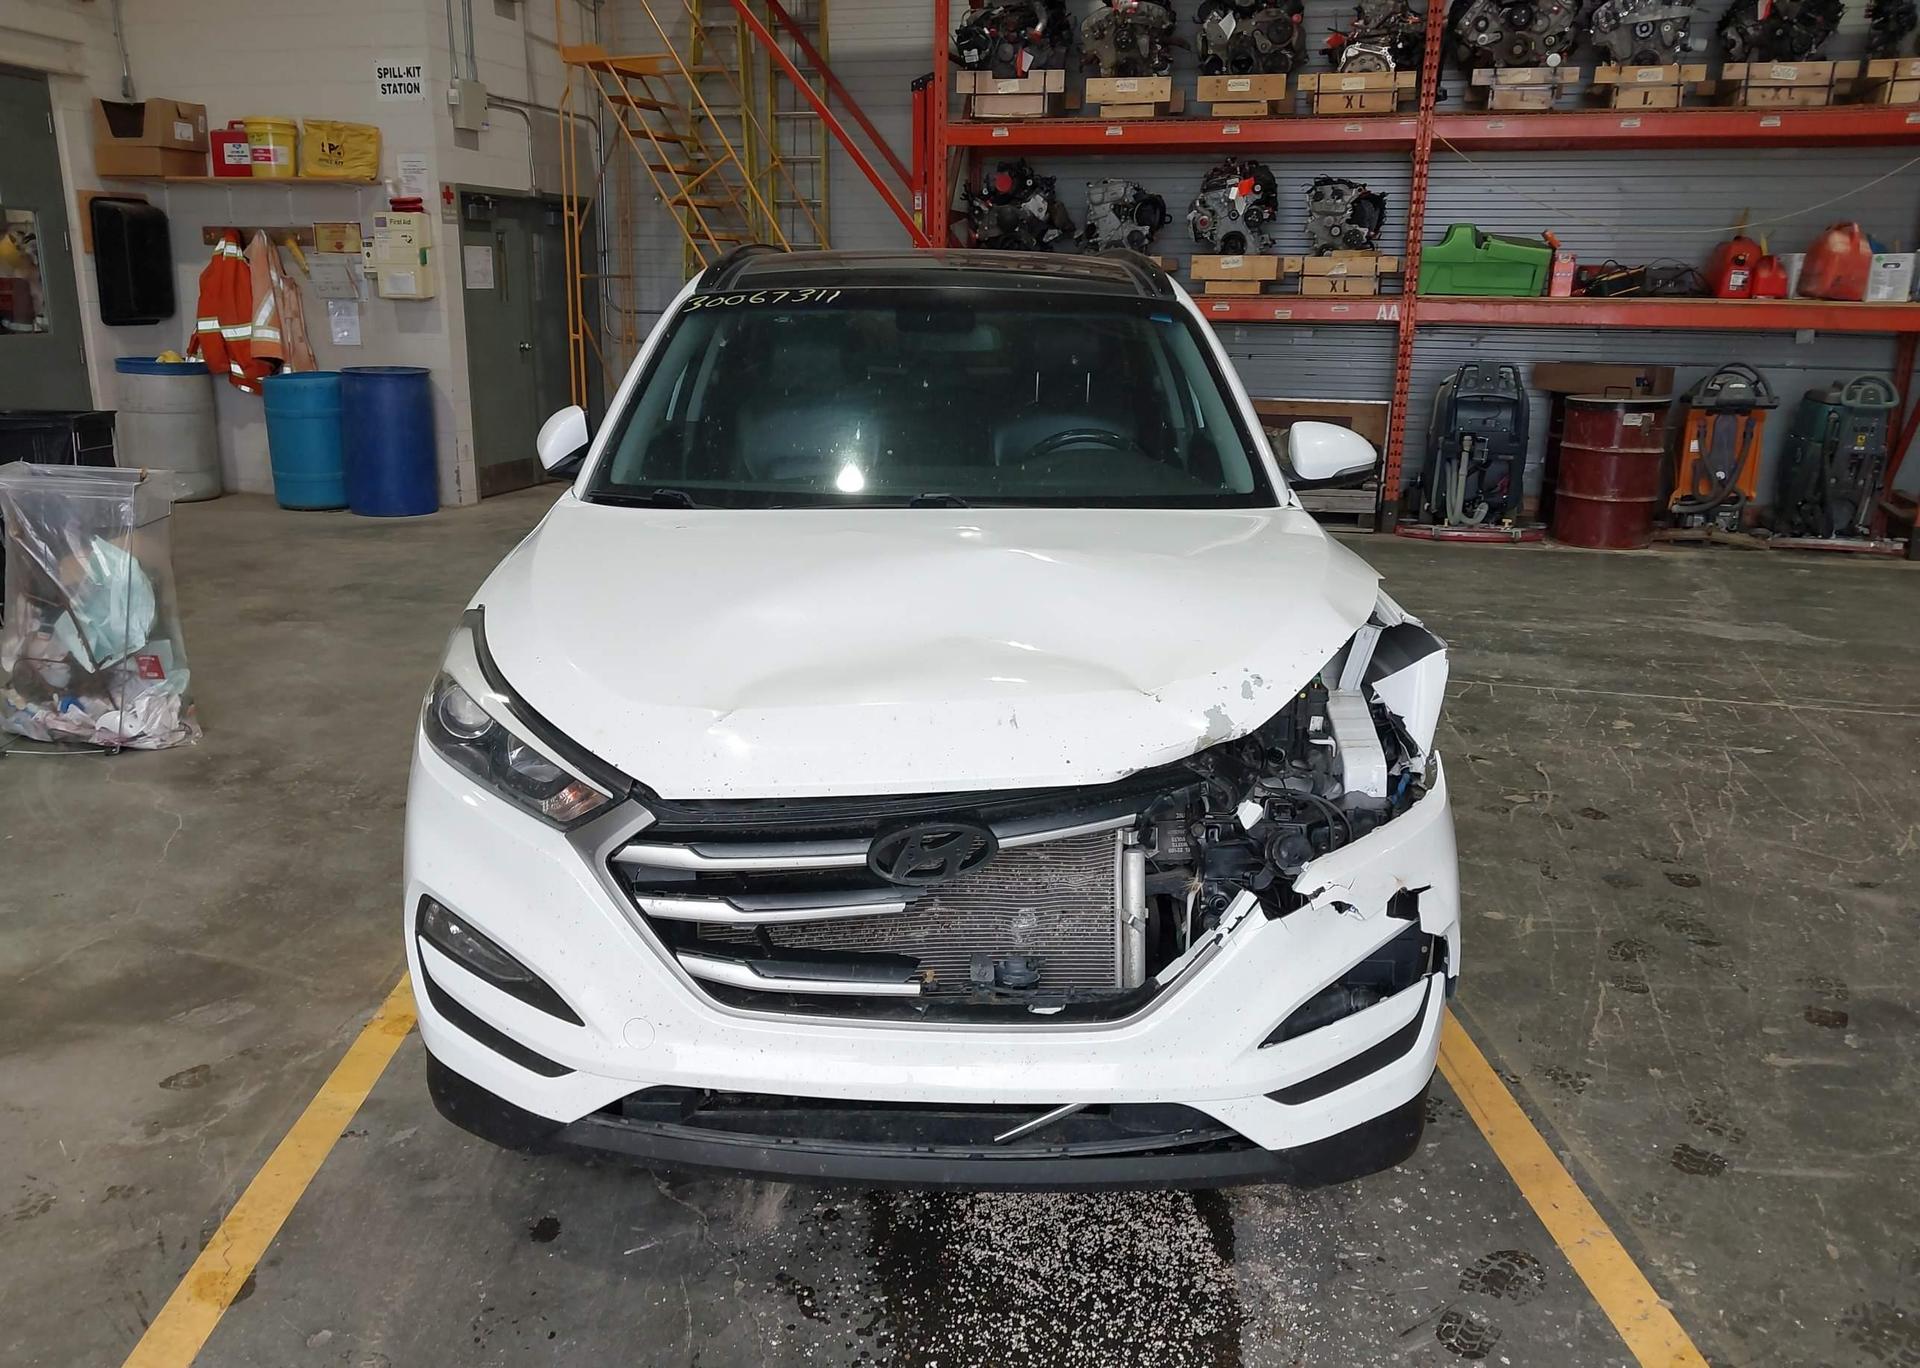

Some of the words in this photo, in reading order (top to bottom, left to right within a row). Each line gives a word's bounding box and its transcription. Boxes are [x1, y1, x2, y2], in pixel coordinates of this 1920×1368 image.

[381, 82, 421, 95] STATION
[683, 289, 841, 313] 30067311
[1375, 303, 1400, 321] AA
